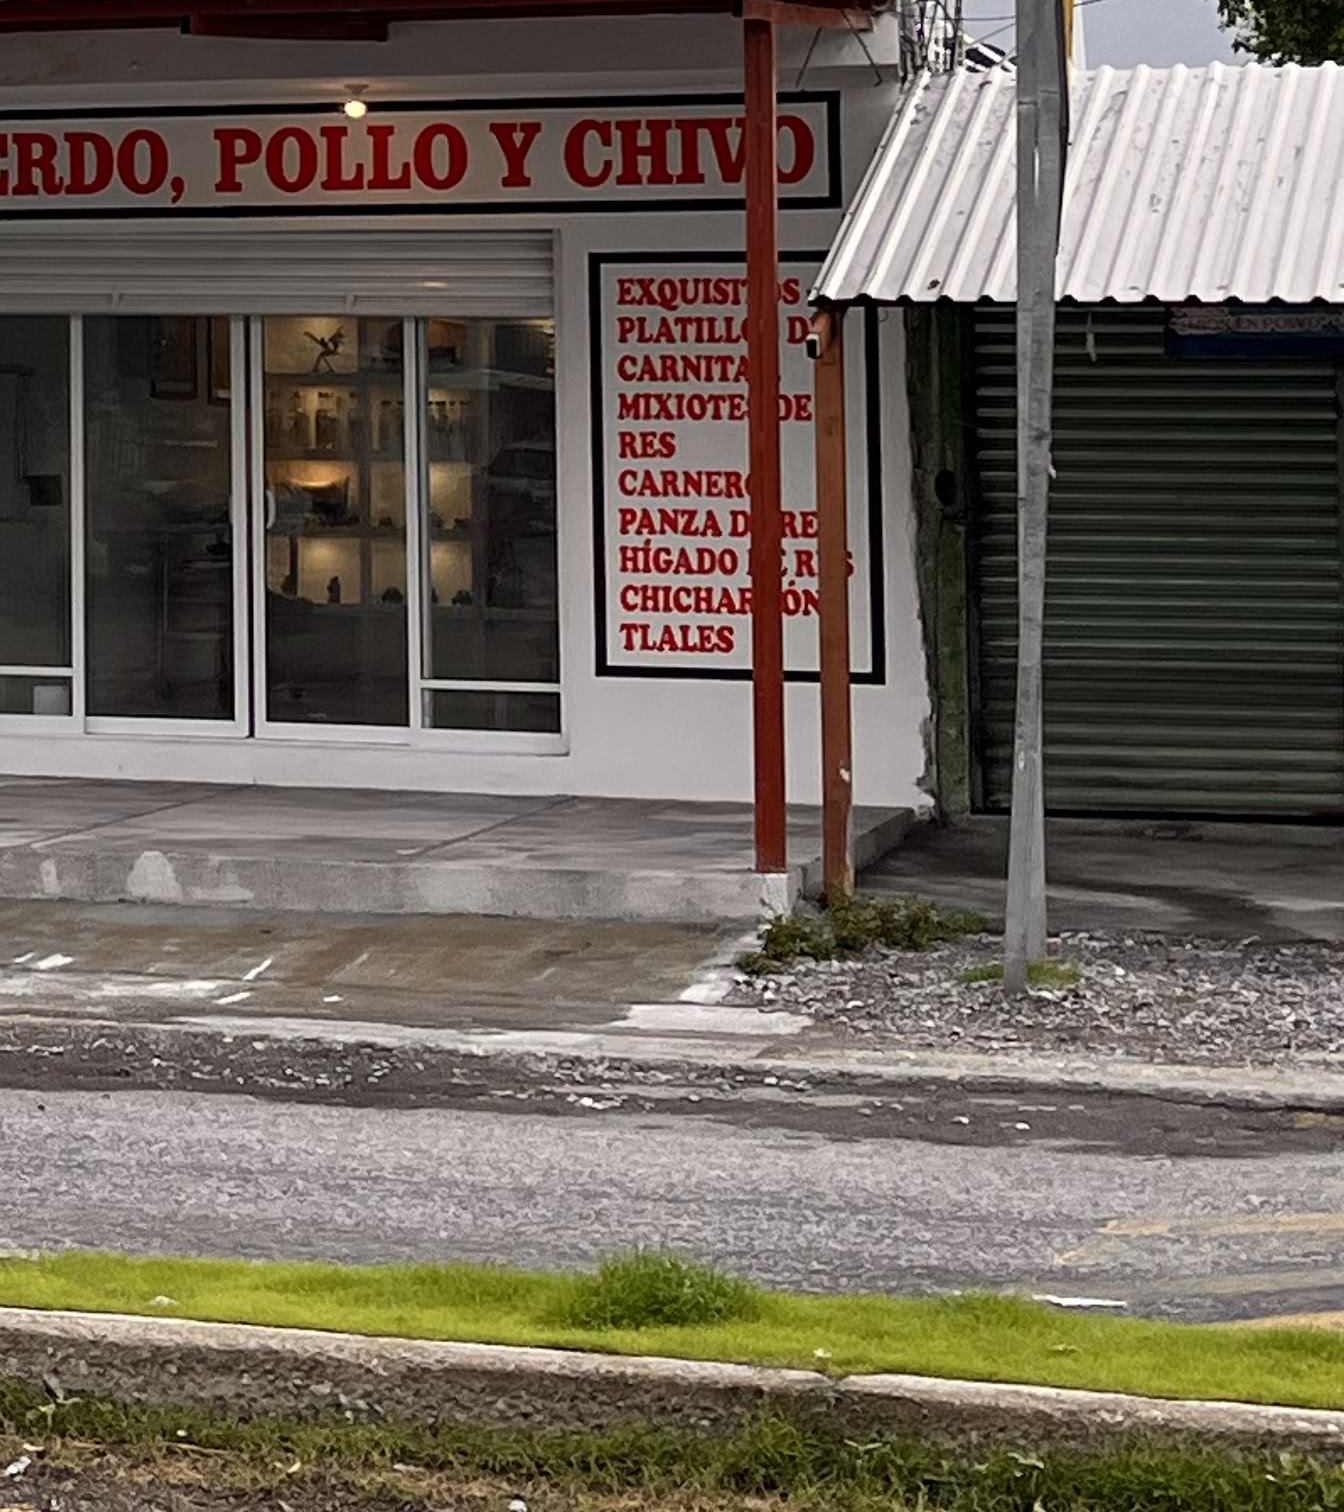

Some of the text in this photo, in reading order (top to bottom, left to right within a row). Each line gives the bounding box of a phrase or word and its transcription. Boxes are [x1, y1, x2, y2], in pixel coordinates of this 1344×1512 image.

[213, 122, 469, 193] POLLO
[489, 122, 542, 187] Y
[564, 115, 815, 187] CHIVO
[787, 316, 811, 344] D
[618, 392, 750, 421] MIXIOTE
[618, 431, 676, 459] RES
[619, 469, 751, 498] CARNER
[618, 508, 820, 539] PANZA D RE
[619, 539, 738, 575] HÍGADO
[620, 580, 820, 616] CHICHARÓN
[620, 622, 734, 653] TLALES
